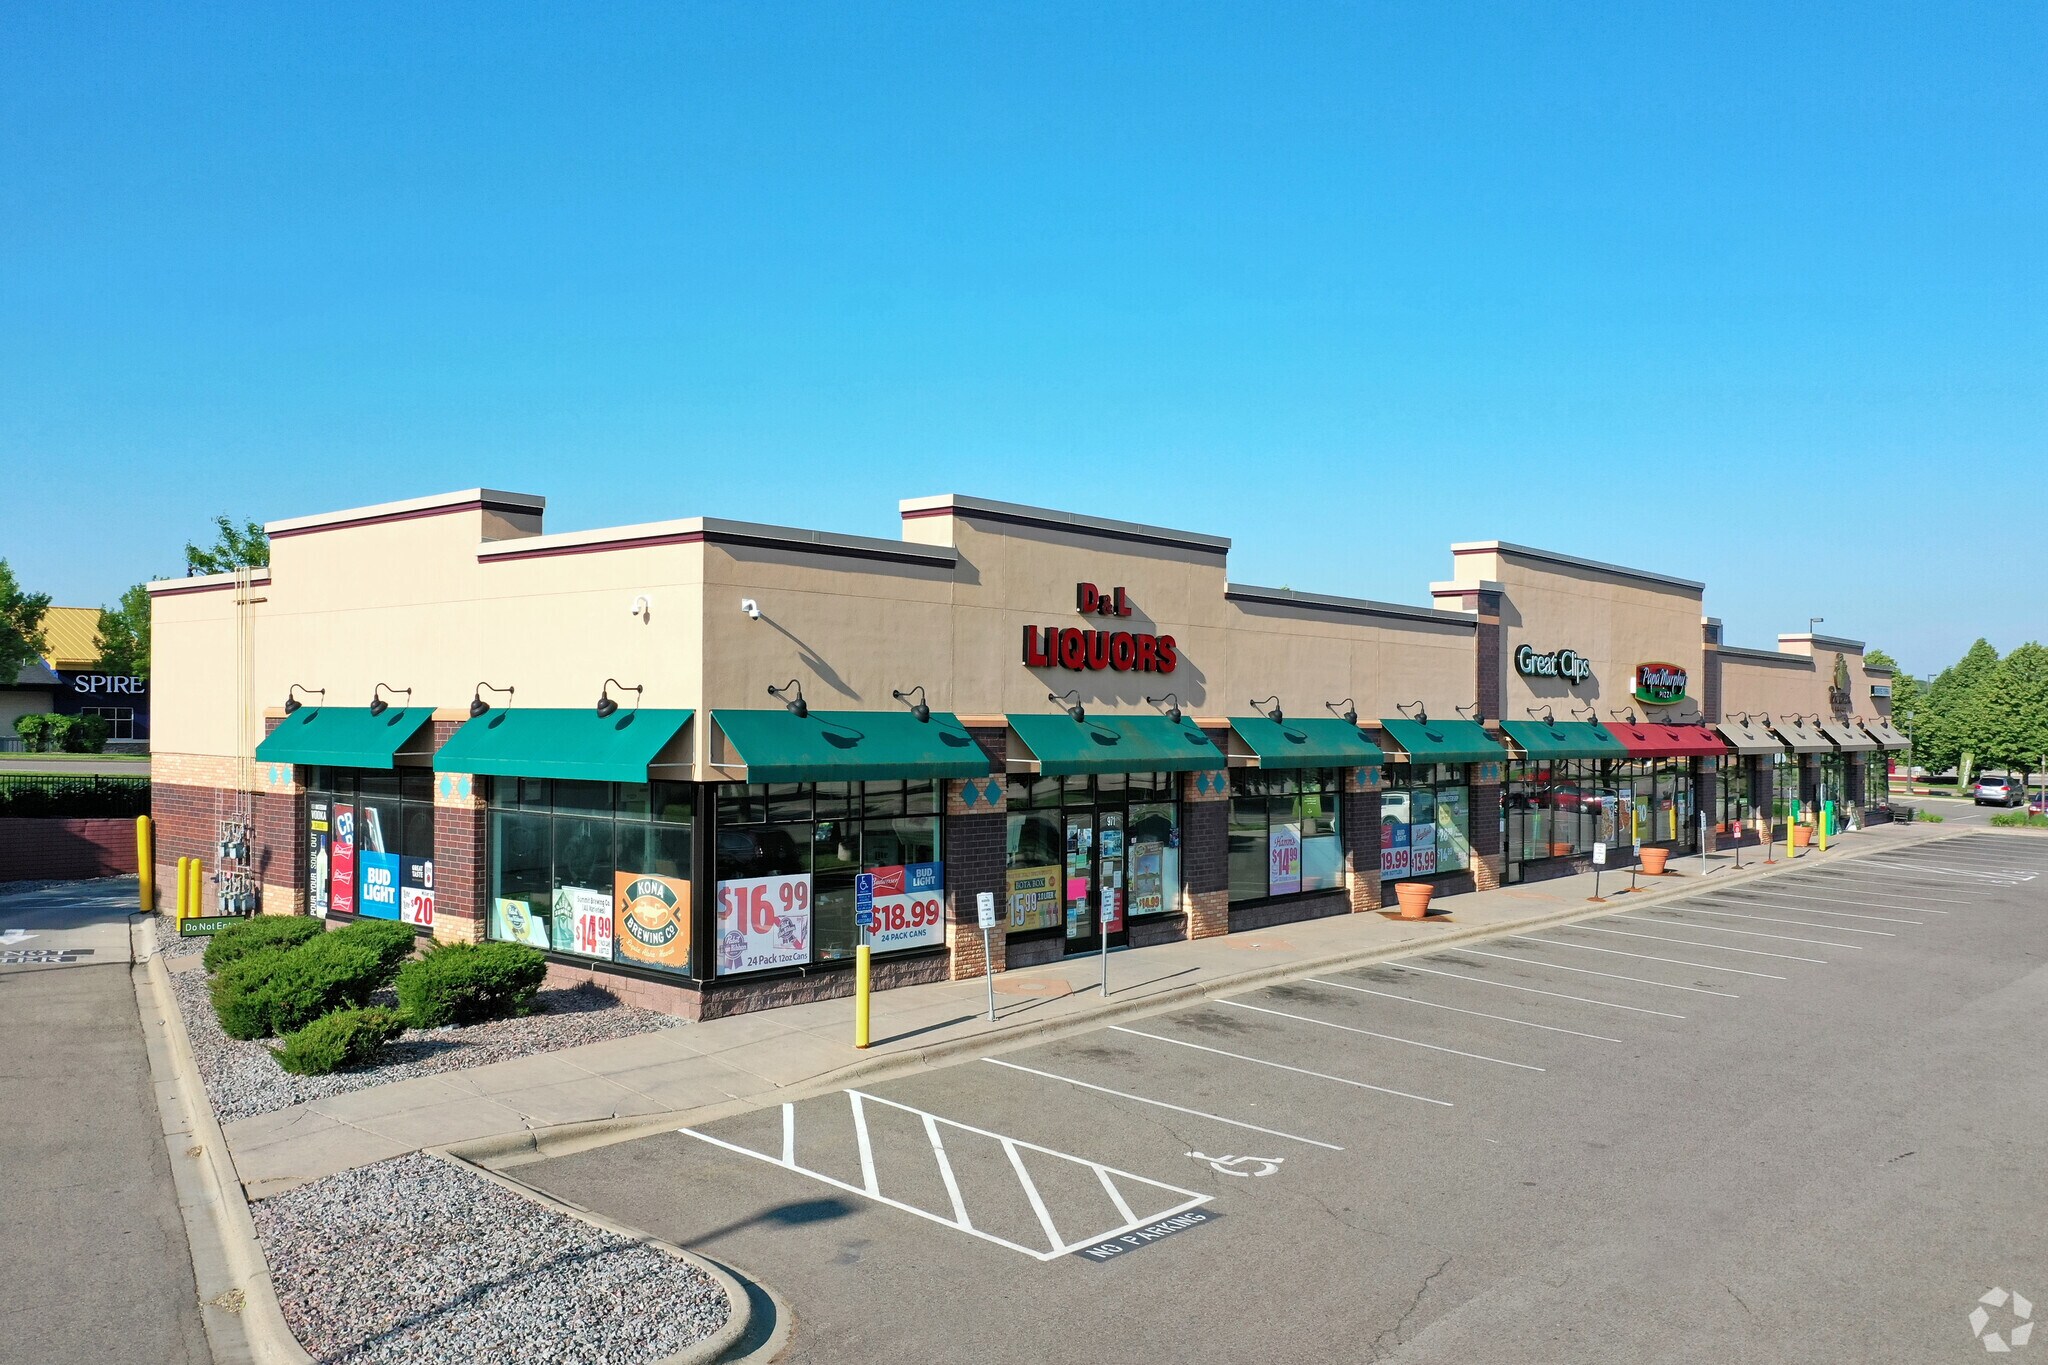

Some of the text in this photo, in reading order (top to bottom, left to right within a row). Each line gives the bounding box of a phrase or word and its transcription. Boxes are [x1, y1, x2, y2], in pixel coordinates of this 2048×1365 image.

[1023, 625, 1177, 673] LIQUORS
[1517, 645, 1590, 684] Great Clips
[75, 675, 145, 694] SPIRE
[1643, 667, 1660, 692] Papa
[1107, 816, 1116, 826] 971
[367, 867, 391, 886] BUD
[913, 876, 936, 887] LIGHT
[916, 867, 933, 877] BUD
[363, 883, 396, 904] LIGHT
[637, 881, 664, 899] KONA
[1015, 879, 1045, 889] BOTA BOX
[185, 923, 198, 932] Do
[199, 922, 215, 931] Not
[866, 899, 939, 936] $18.99
[627, 917, 665, 943] BREWING
[881, 929, 927, 942] 24 PACK CANS
[747, 952, 808, 967] 24 Pack 12oz Cans
[1085, 1212, 1206, 1258] NO PARKING
